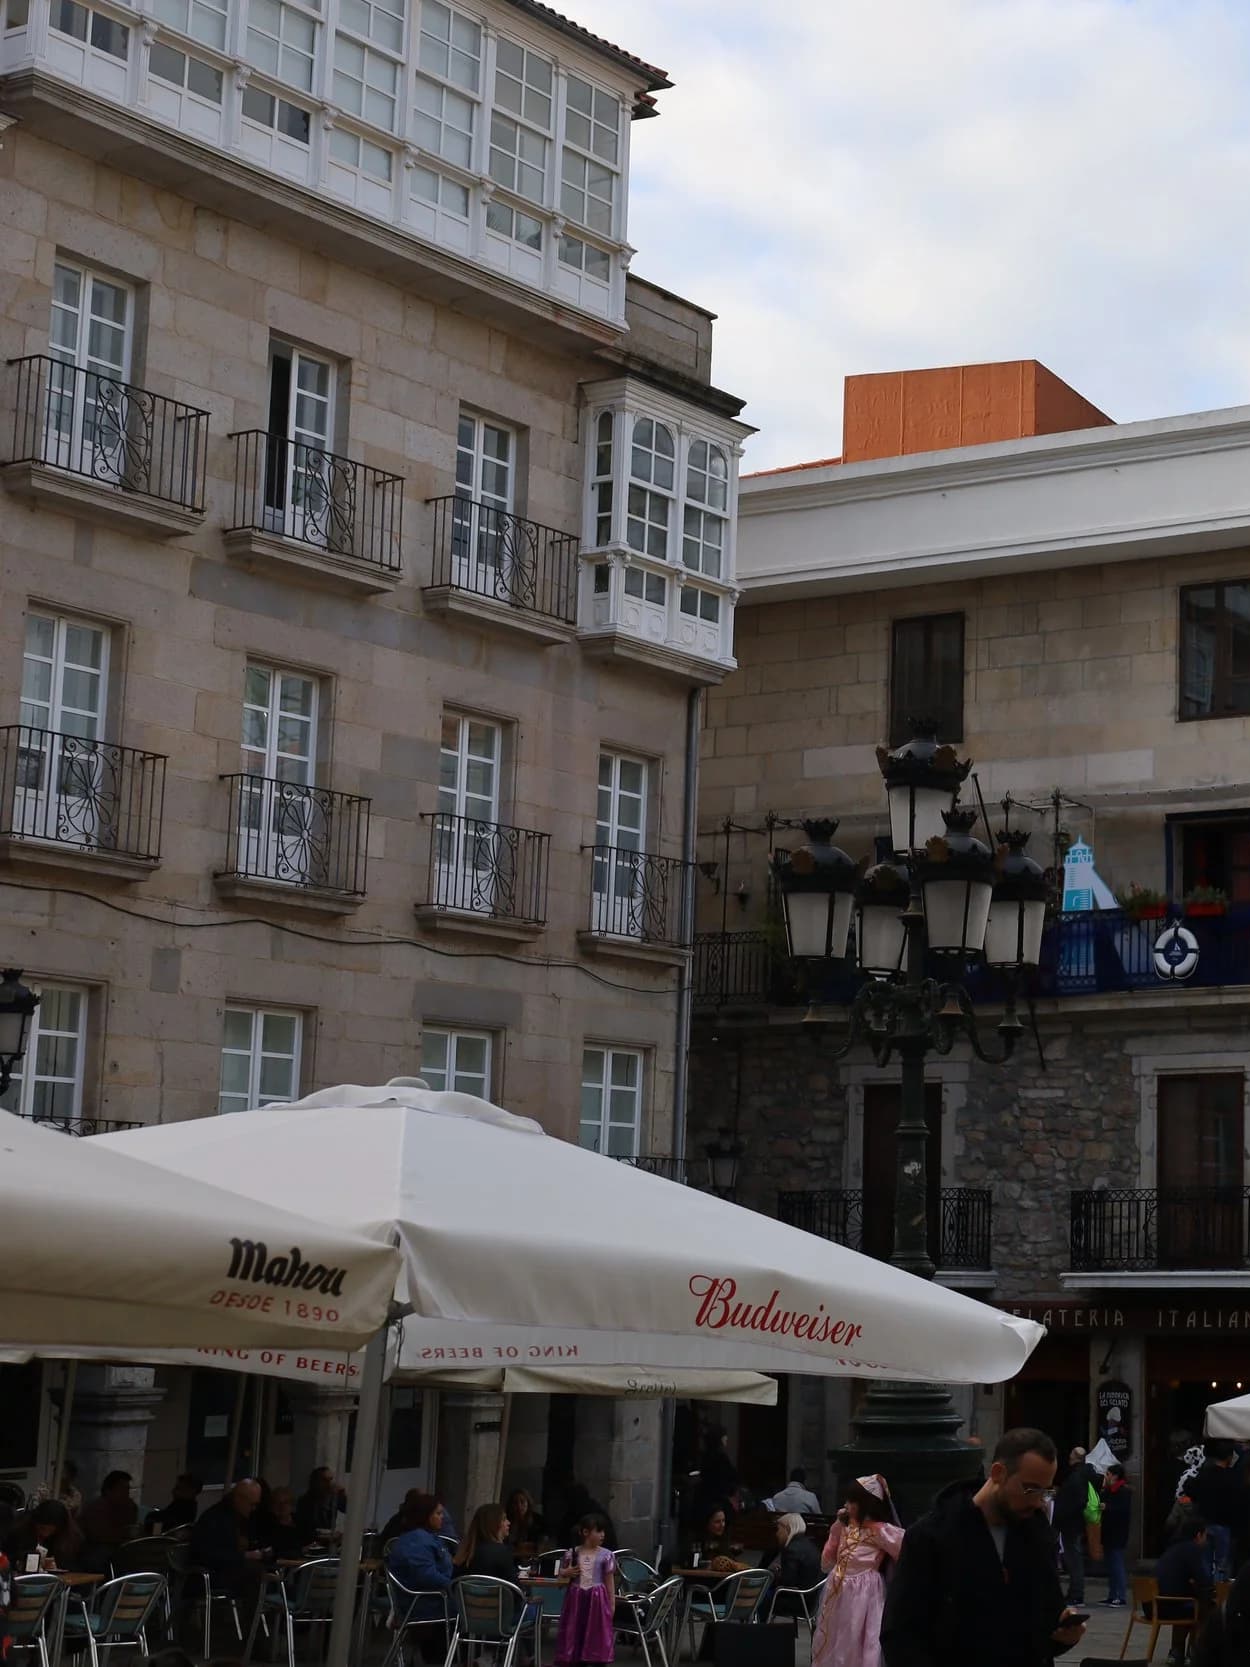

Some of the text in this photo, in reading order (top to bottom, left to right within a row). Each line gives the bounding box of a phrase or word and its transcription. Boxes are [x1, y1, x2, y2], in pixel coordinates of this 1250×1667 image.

[227, 1237, 347, 1297] Mahou
[209, 1290, 340, 1322] DESDE 1890
[689, 1275, 862, 1346] Budweiser
[1012, 1308, 1124, 1328] LATERIA
[260, 1351, 286, 1365] OF
